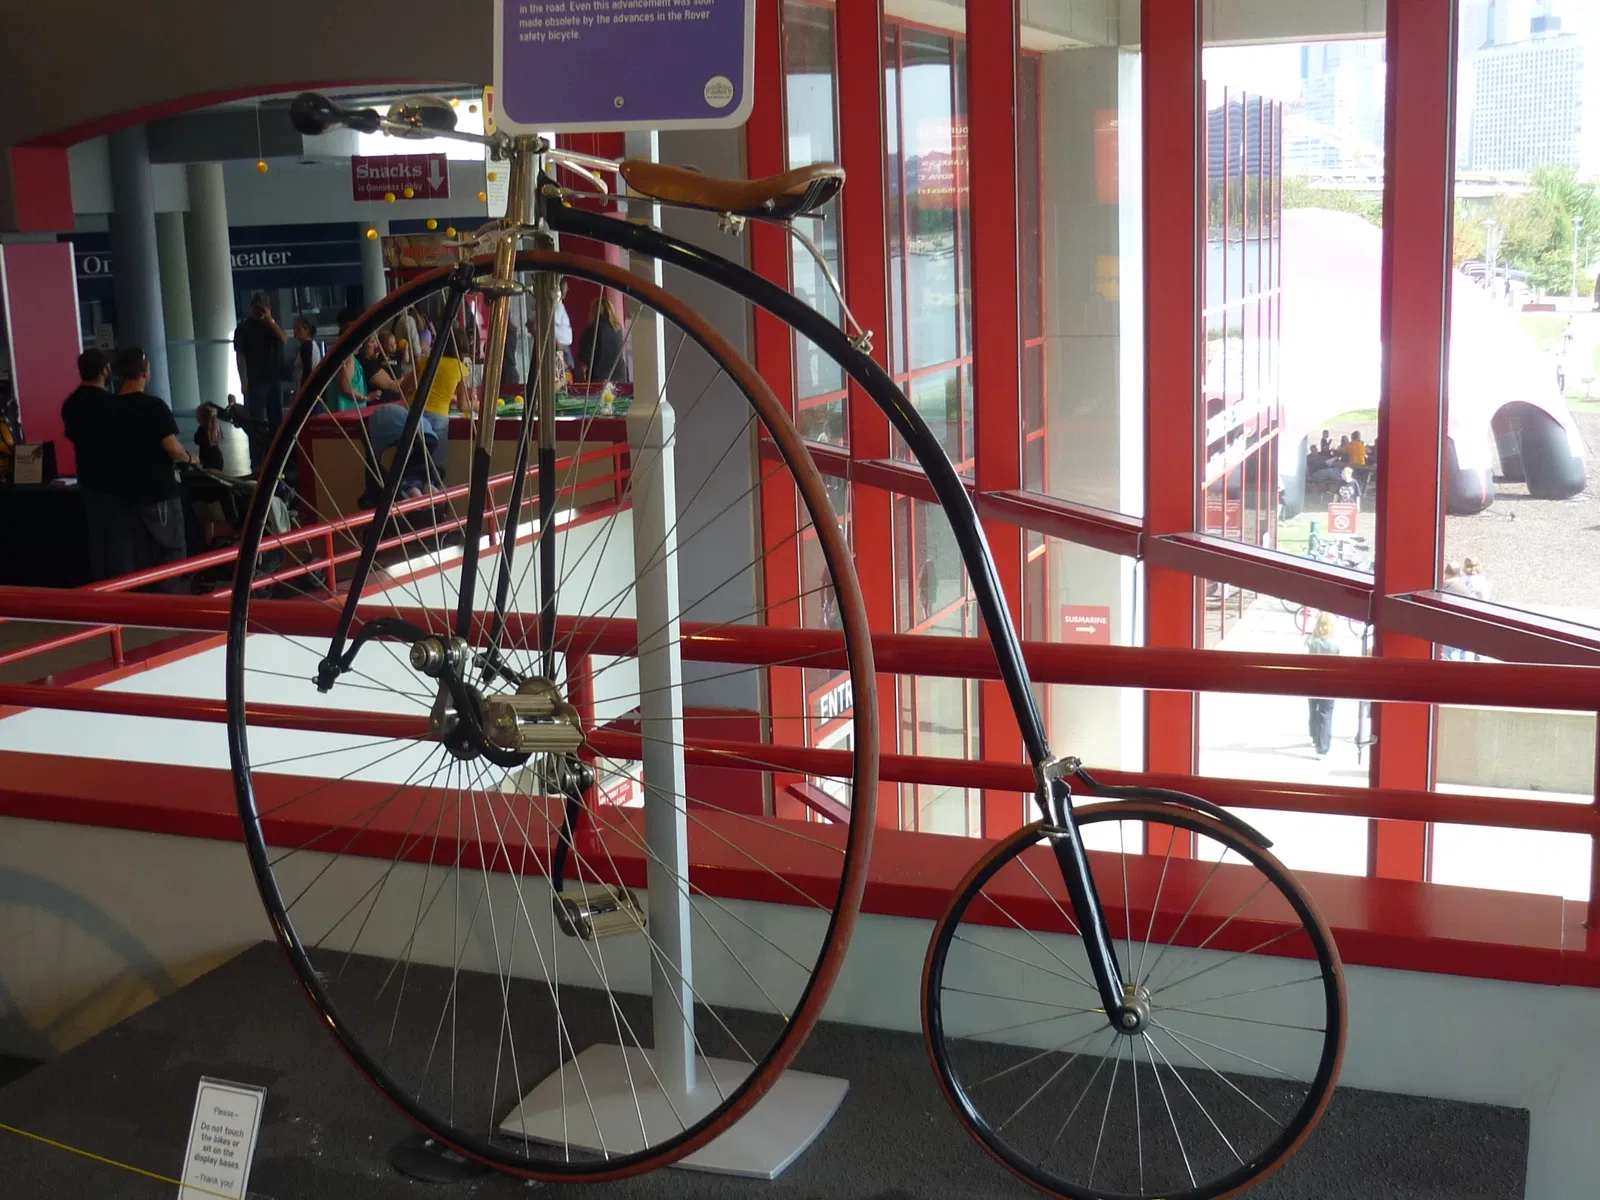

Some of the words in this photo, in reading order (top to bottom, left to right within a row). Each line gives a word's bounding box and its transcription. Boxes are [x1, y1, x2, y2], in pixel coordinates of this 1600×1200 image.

[519, 5, 528, 14] in
[529, 3, 544, 13] the
[545, 2, 568, 13] road.
[569, 1, 592, 12] Even
[593, 0, 610, 10] this
[612, 0, 671, 9] advancement
[519, 17, 543, 28] made
[544, 15, 581, 27] obsolete
[582, 15, 594, 28] by
[596, 14, 611, 24] the
[612, 11, 654, 23] advances
[656, 10, 666, 21] in
[667, 10, 682, 21] the
[684, 9, 711, 20] Rover
[519, 31, 546, 43] safety
[548, 29, 581, 42] bicycle.
[356, 163, 422, 179] Snacks
[366, 183, 400, 192] Omnimax
[1064, 615, 1107, 624] SUBMARINE
[820, 679, 853, 725] ENTR
[201, 1121, 211, 1132] Do
[211, 1124, 223, 1133] not
[225, 1127, 244, 1138] touch
[201, 1133, 213, 1142] the
[213, 1135, 231, 1146] bikes
[232, 1140, 240, 1148] or
[203, 1144, 212, 1153] sit
[213, 1147, 221, 1155] on
[223, 1148, 234, 1158] the
[194, 1153, 217, 1167] display
[219, 1158, 240, 1169] bases.
